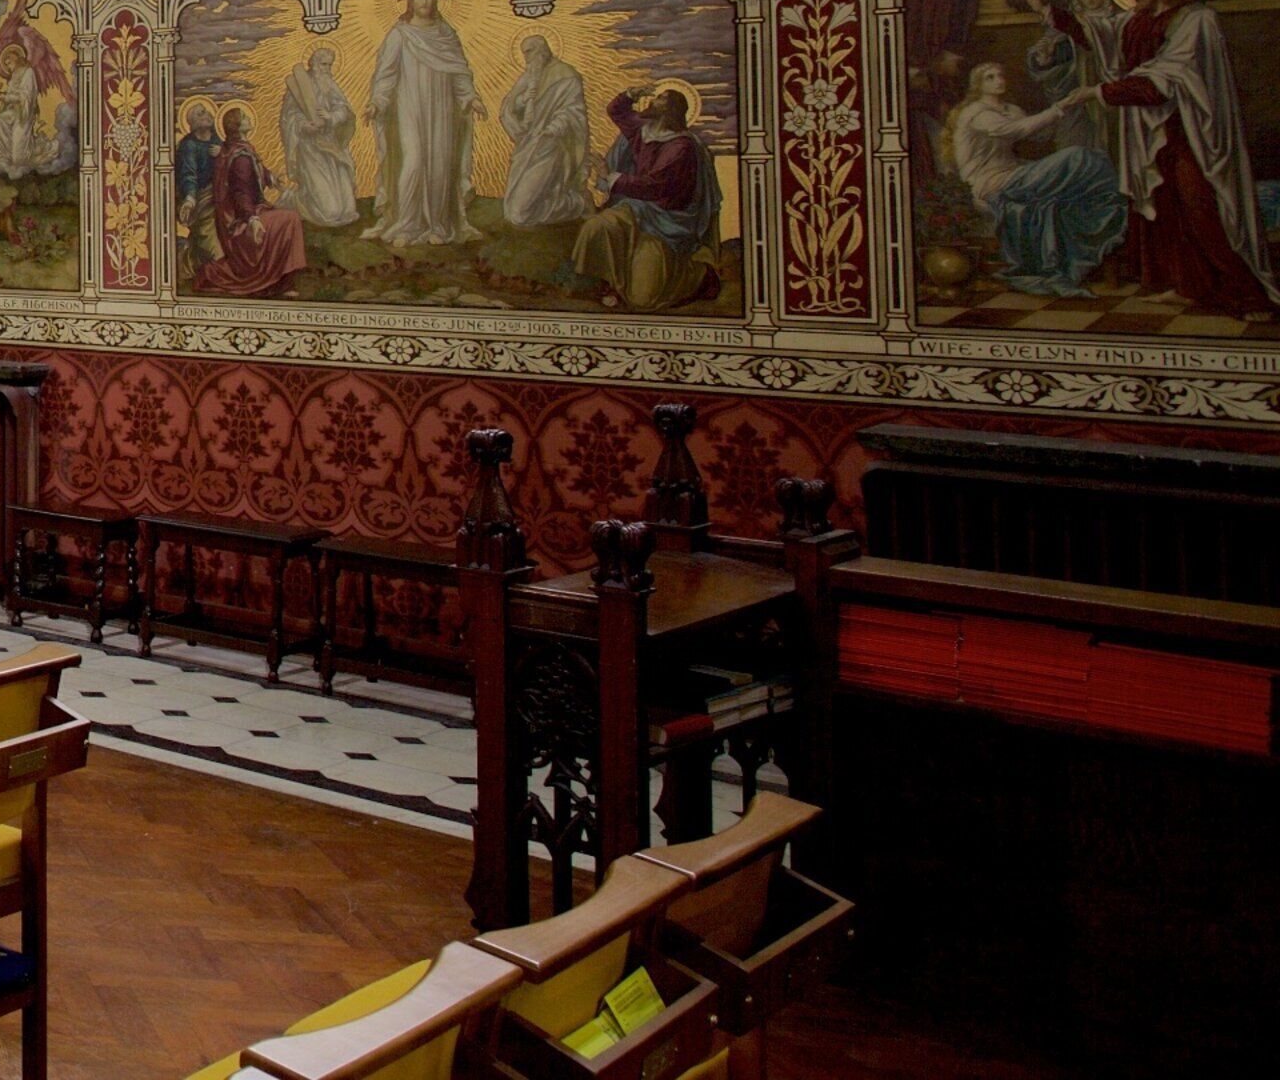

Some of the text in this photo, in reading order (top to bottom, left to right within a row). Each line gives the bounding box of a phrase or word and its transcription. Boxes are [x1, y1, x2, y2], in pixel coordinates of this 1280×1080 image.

[178, 306, 209, 317] BORN
[269, 311, 291, 322] 1861
[296, 311, 358, 325] ENTERED
[363, 315, 397, 326] INTO
[403, 317, 440, 329] REST
[447, 320, 485, 331] JUNE
[570, 324, 672, 340] PRESENTED
[683, 329, 706, 342] BY
[714, 331, 744, 344] HIS
[919, 341, 972, 356] WIFE
[990, 344, 1076, 361] EVELYN
[1096, 349, 1144, 364] AND
[1162, 352, 1203, 367] HIS
